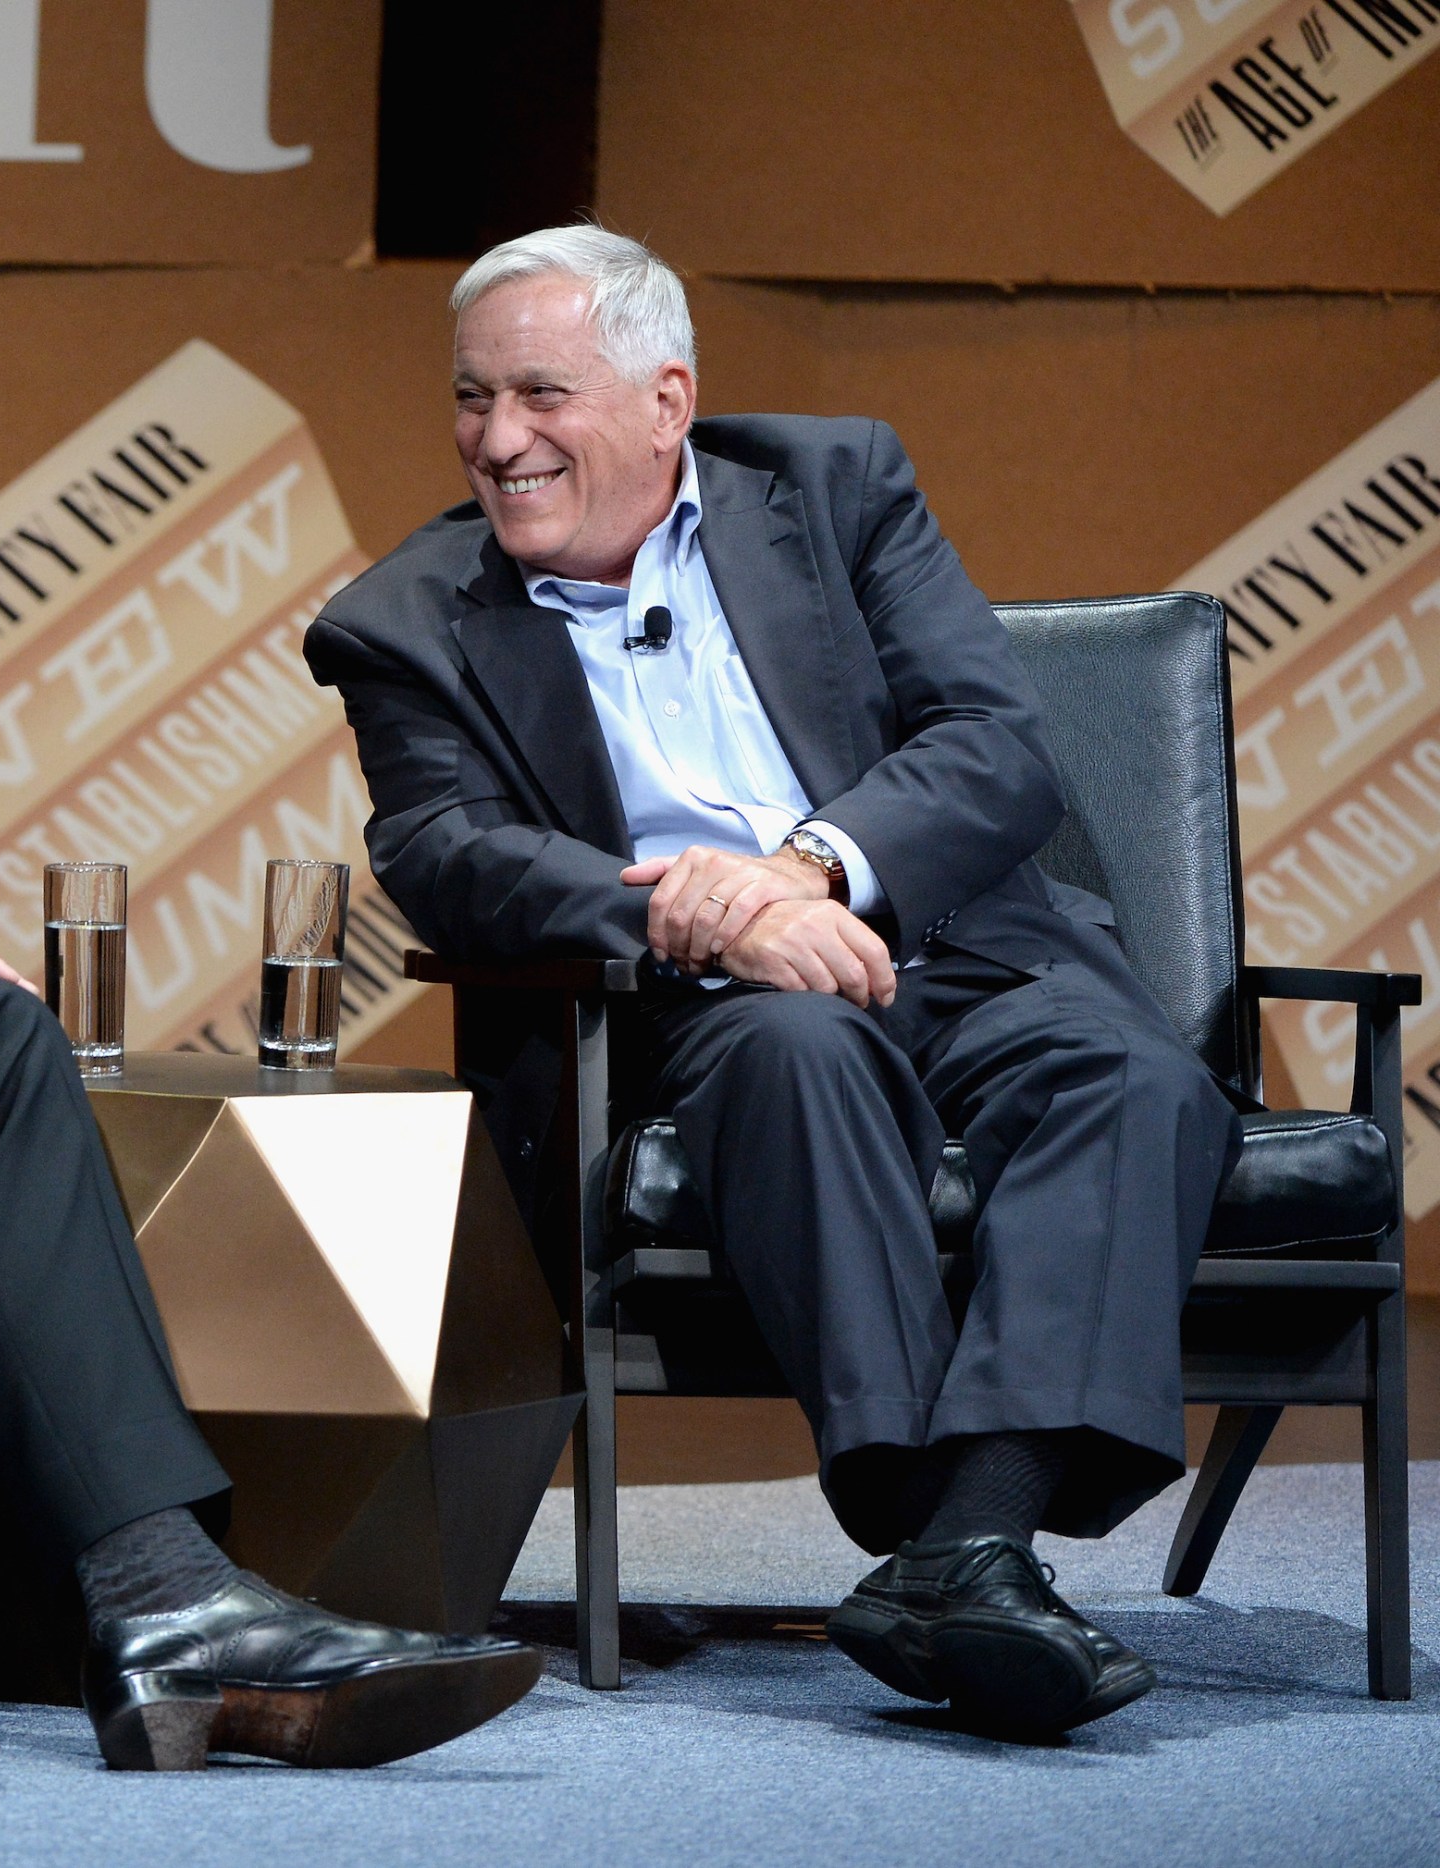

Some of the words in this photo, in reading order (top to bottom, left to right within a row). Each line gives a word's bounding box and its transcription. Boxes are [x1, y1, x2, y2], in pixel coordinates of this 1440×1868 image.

[1174, 94, 1218, 160] THE
[1207, 36, 1339, 152] AGE
[1299, 4, 1330, 63] OF
[57, 422, 208, 547] FAIR
[1224, 541, 1335, 663] ITY
[124, 750, 372, 1012] UMM
